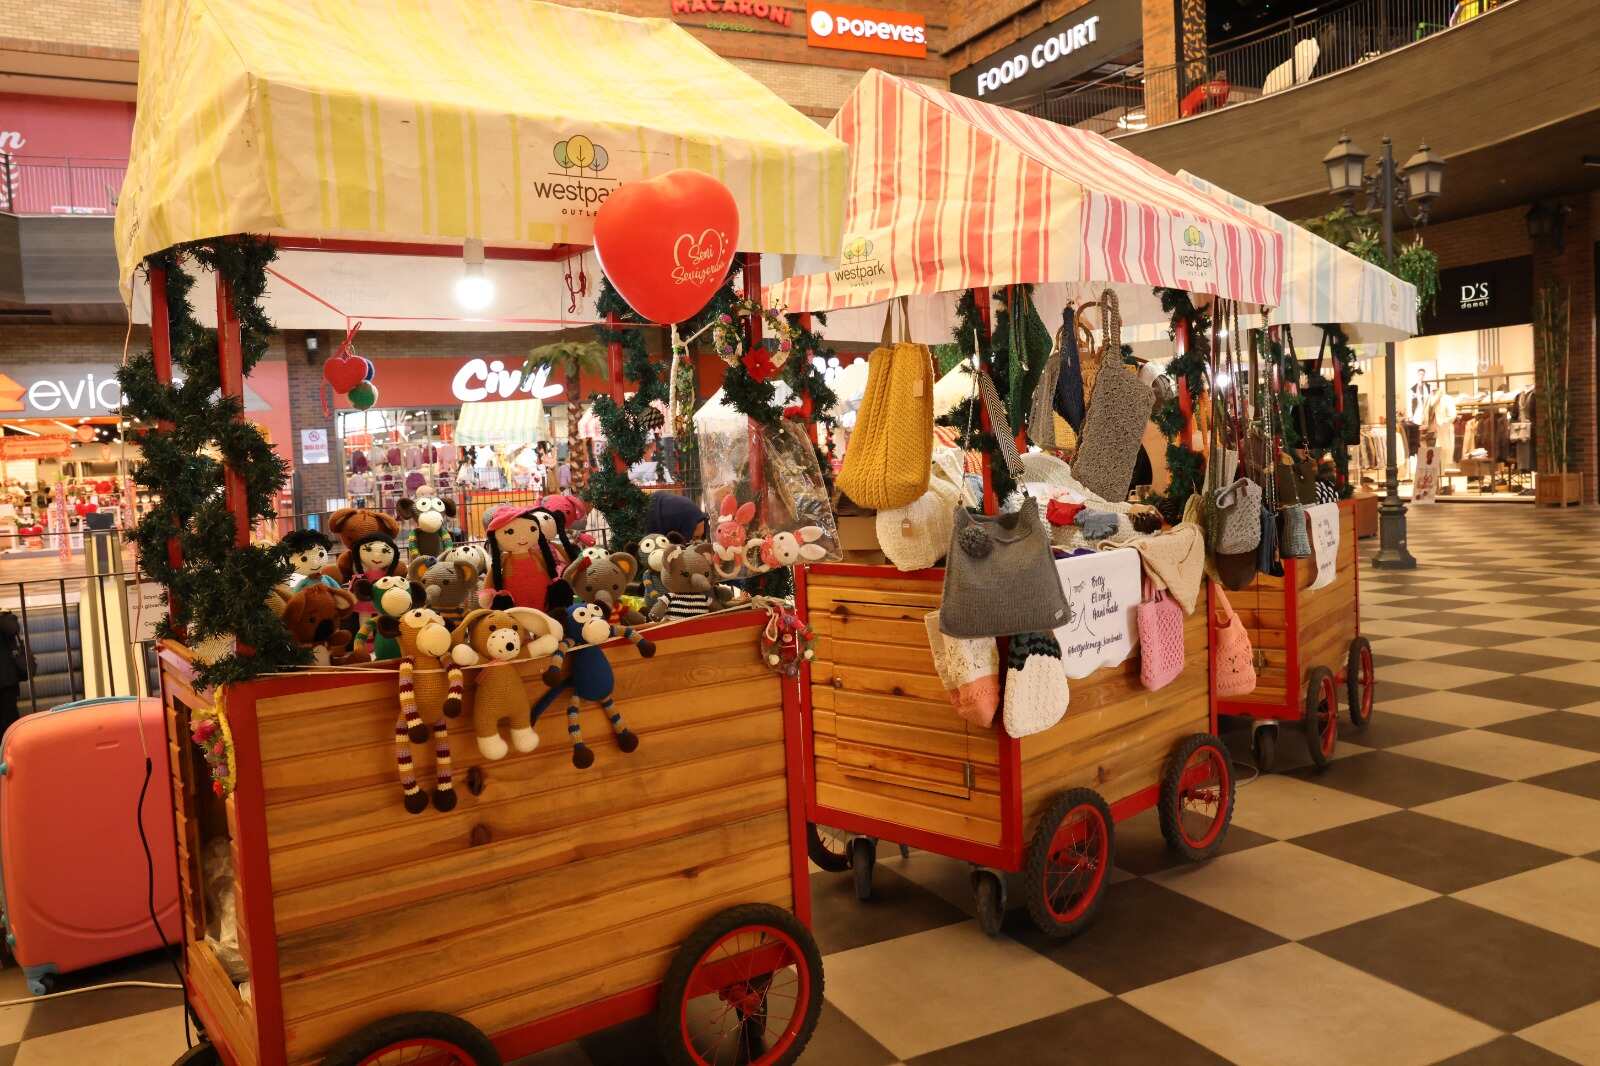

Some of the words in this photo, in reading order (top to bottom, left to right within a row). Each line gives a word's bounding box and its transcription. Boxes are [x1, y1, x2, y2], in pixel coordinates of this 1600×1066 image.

[671, 0, 794, 27] MACARONI
[977, 54, 1030, 96] FOOD
[1031, 15, 1100, 69] COURT
[534, 180, 622, 208] westpa
[561, 208, 598, 217] OUTLE
[834, 260, 886, 281] westpark
[1461, 282, 1489, 301] D'S
